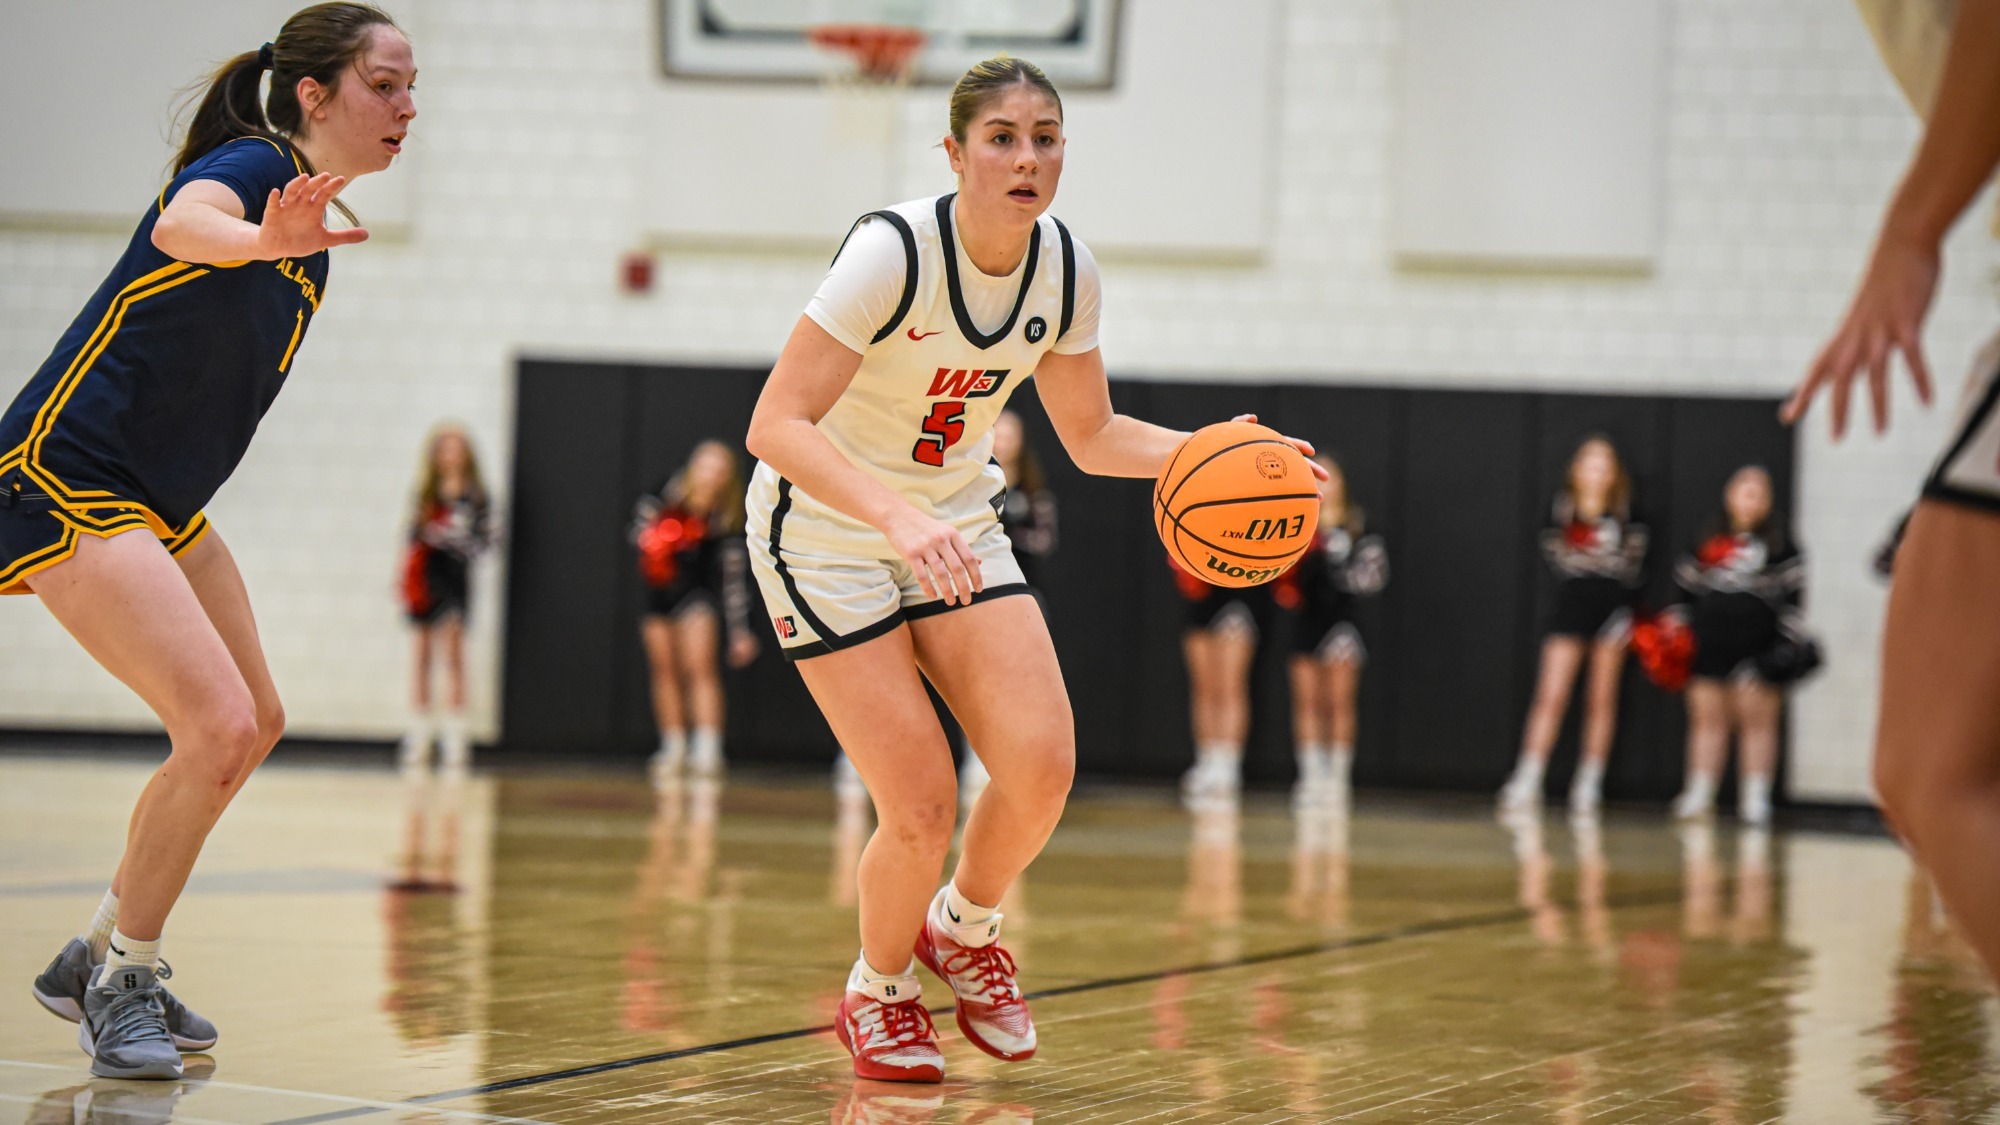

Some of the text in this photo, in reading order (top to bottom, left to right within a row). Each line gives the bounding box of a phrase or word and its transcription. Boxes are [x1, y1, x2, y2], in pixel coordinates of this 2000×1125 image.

[278, 308, 304, 373] 1
[1030, 323, 1042, 337] VS
[926, 367, 1012, 399] W&J
[912, 401, 967, 468] 5
[1220, 514, 1305, 541] EVO NXT
